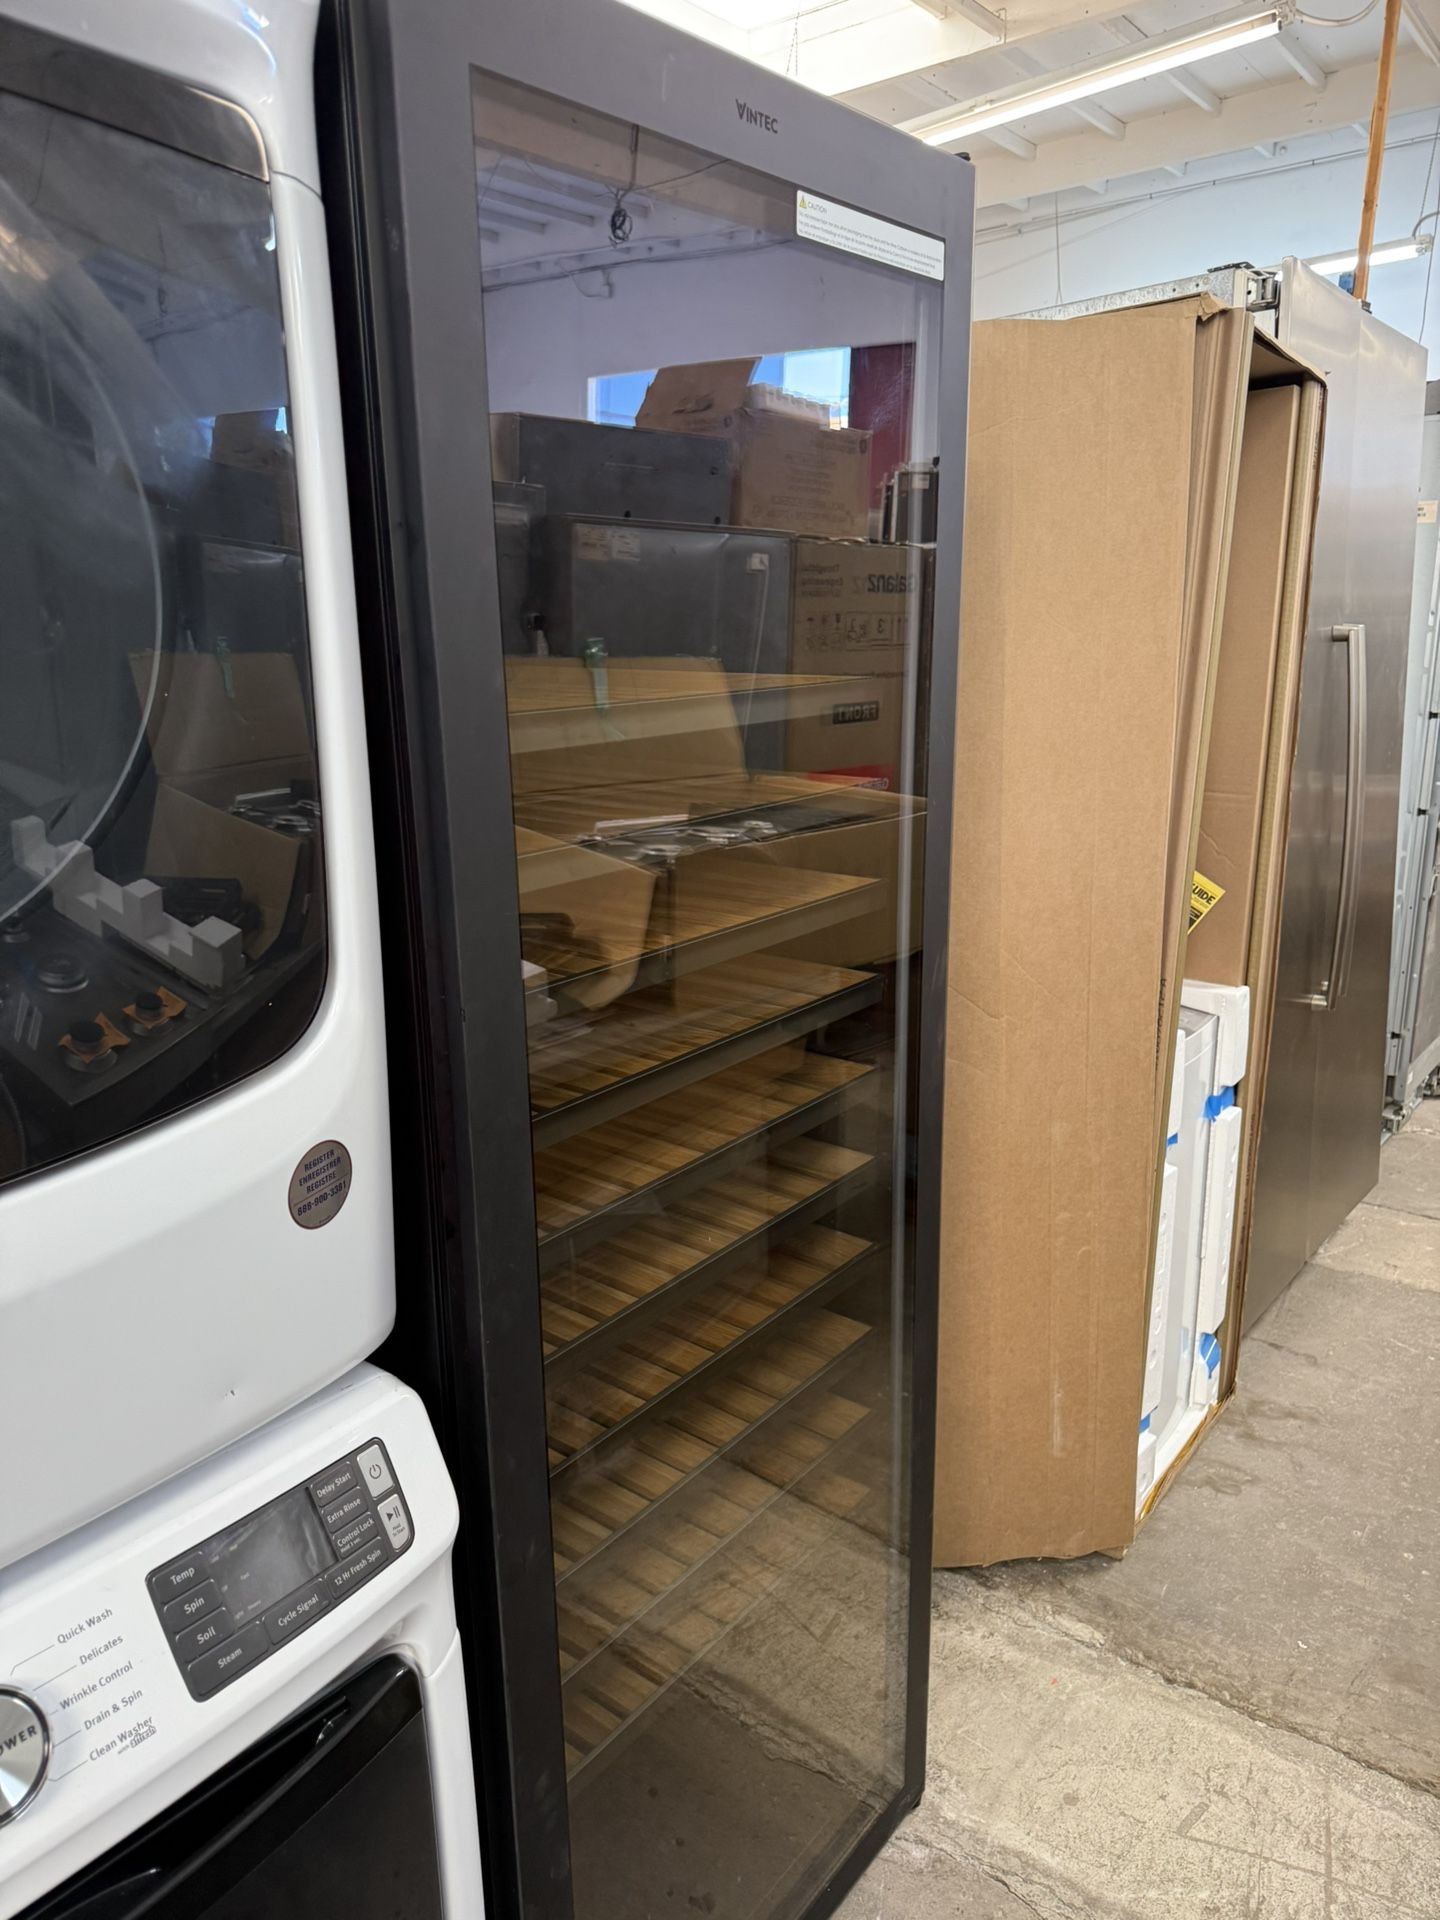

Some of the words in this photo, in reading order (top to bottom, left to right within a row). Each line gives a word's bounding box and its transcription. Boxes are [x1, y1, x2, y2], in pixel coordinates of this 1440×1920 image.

[735, 99, 778, 134] VINTEC
[1192, 883, 1216, 905] UIDE
[298, 1156, 342, 1186] ENREGISTRER
[304, 1149, 335, 1172] REGISTER
[316, 1481, 335, 1498] Delay
[334, 1472, 351, 1487] Start
[327, 1511, 344, 1524] Extra
[343, 1497, 361, 1515] Rinse
[337, 1526, 359, 1547] Control
[358, 1516, 375, 1532] Lock
[170, 1564, 196, 1586] Temp
[334, 1575, 343, 1586] 12
[342, 1569, 352, 1582] Hr
[350, 1558, 368, 1575] Fresh
[367, 1548, 382, 1563] Spin
[183, 1596, 205, 1616] Spin
[277, 1607, 298, 1628] Cycle
[297, 1593, 320, 1616] Signal
[57, 1623, 86, 1645] Quick
[85, 1607, 114, 1629] Wash
[196, 1625, 217, 1645] Soil
[79, 1634, 124, 1665] Delicates
[217, 1646, 243, 1670] Steam
[59, 1682, 99, 1711] Wrinkle
[98, 1660, 134, 1688] Control
[83, 1708, 112, 1731] Drain
[111, 1702, 121, 1714] &
[120, 1687, 144, 1709] Spin
[89, 1739, 118, 1762] Clean
[116, 1715, 153, 1744] Washer
